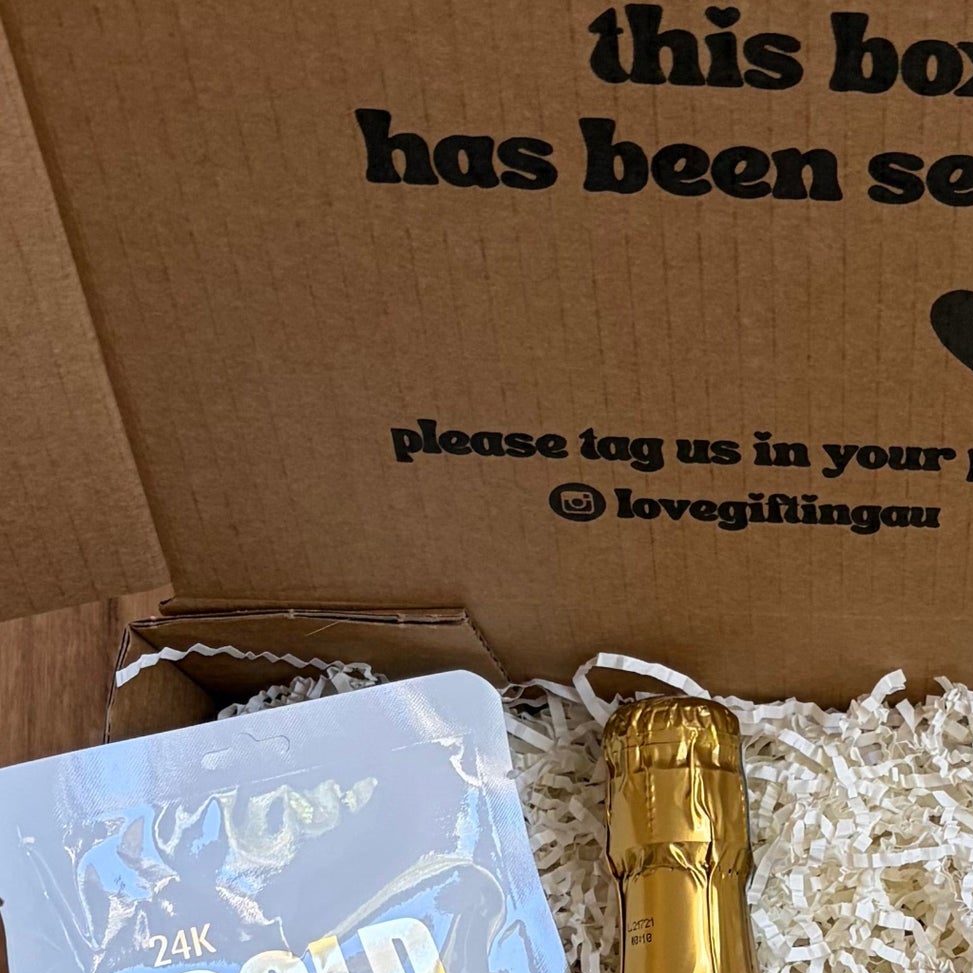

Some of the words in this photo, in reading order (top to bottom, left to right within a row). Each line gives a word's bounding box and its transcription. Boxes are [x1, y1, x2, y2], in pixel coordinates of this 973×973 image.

[588, 3, 803, 91] this
[355, 108, 558, 190] has
[579, 117, 843, 201] been
[390, 419, 568, 462] please
[579, 427, 664, 472] tag
[676, 439, 741, 466] us
[753, 431, 810, 468] in
[822, 440, 956, 478] your
[616, 488, 940, 534] lovegiftingau
[151, 923, 217, 967] 24K
